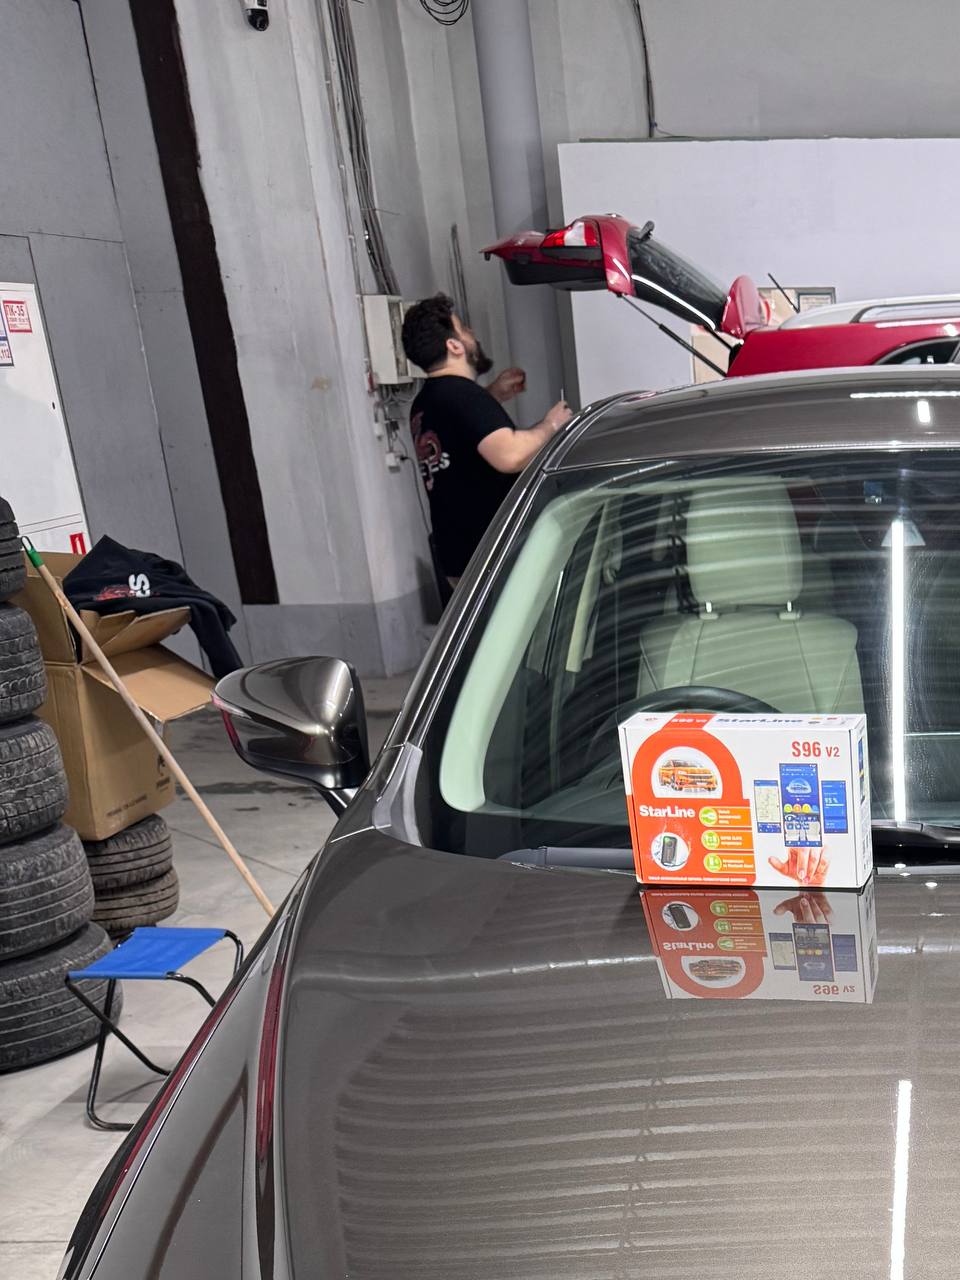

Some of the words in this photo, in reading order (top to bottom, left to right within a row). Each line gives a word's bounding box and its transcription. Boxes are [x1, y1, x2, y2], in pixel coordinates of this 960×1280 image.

[791, 740, 822, 758] S96
[825, 746, 840, 758] V2
[639, 805, 696, 818] StarLine
